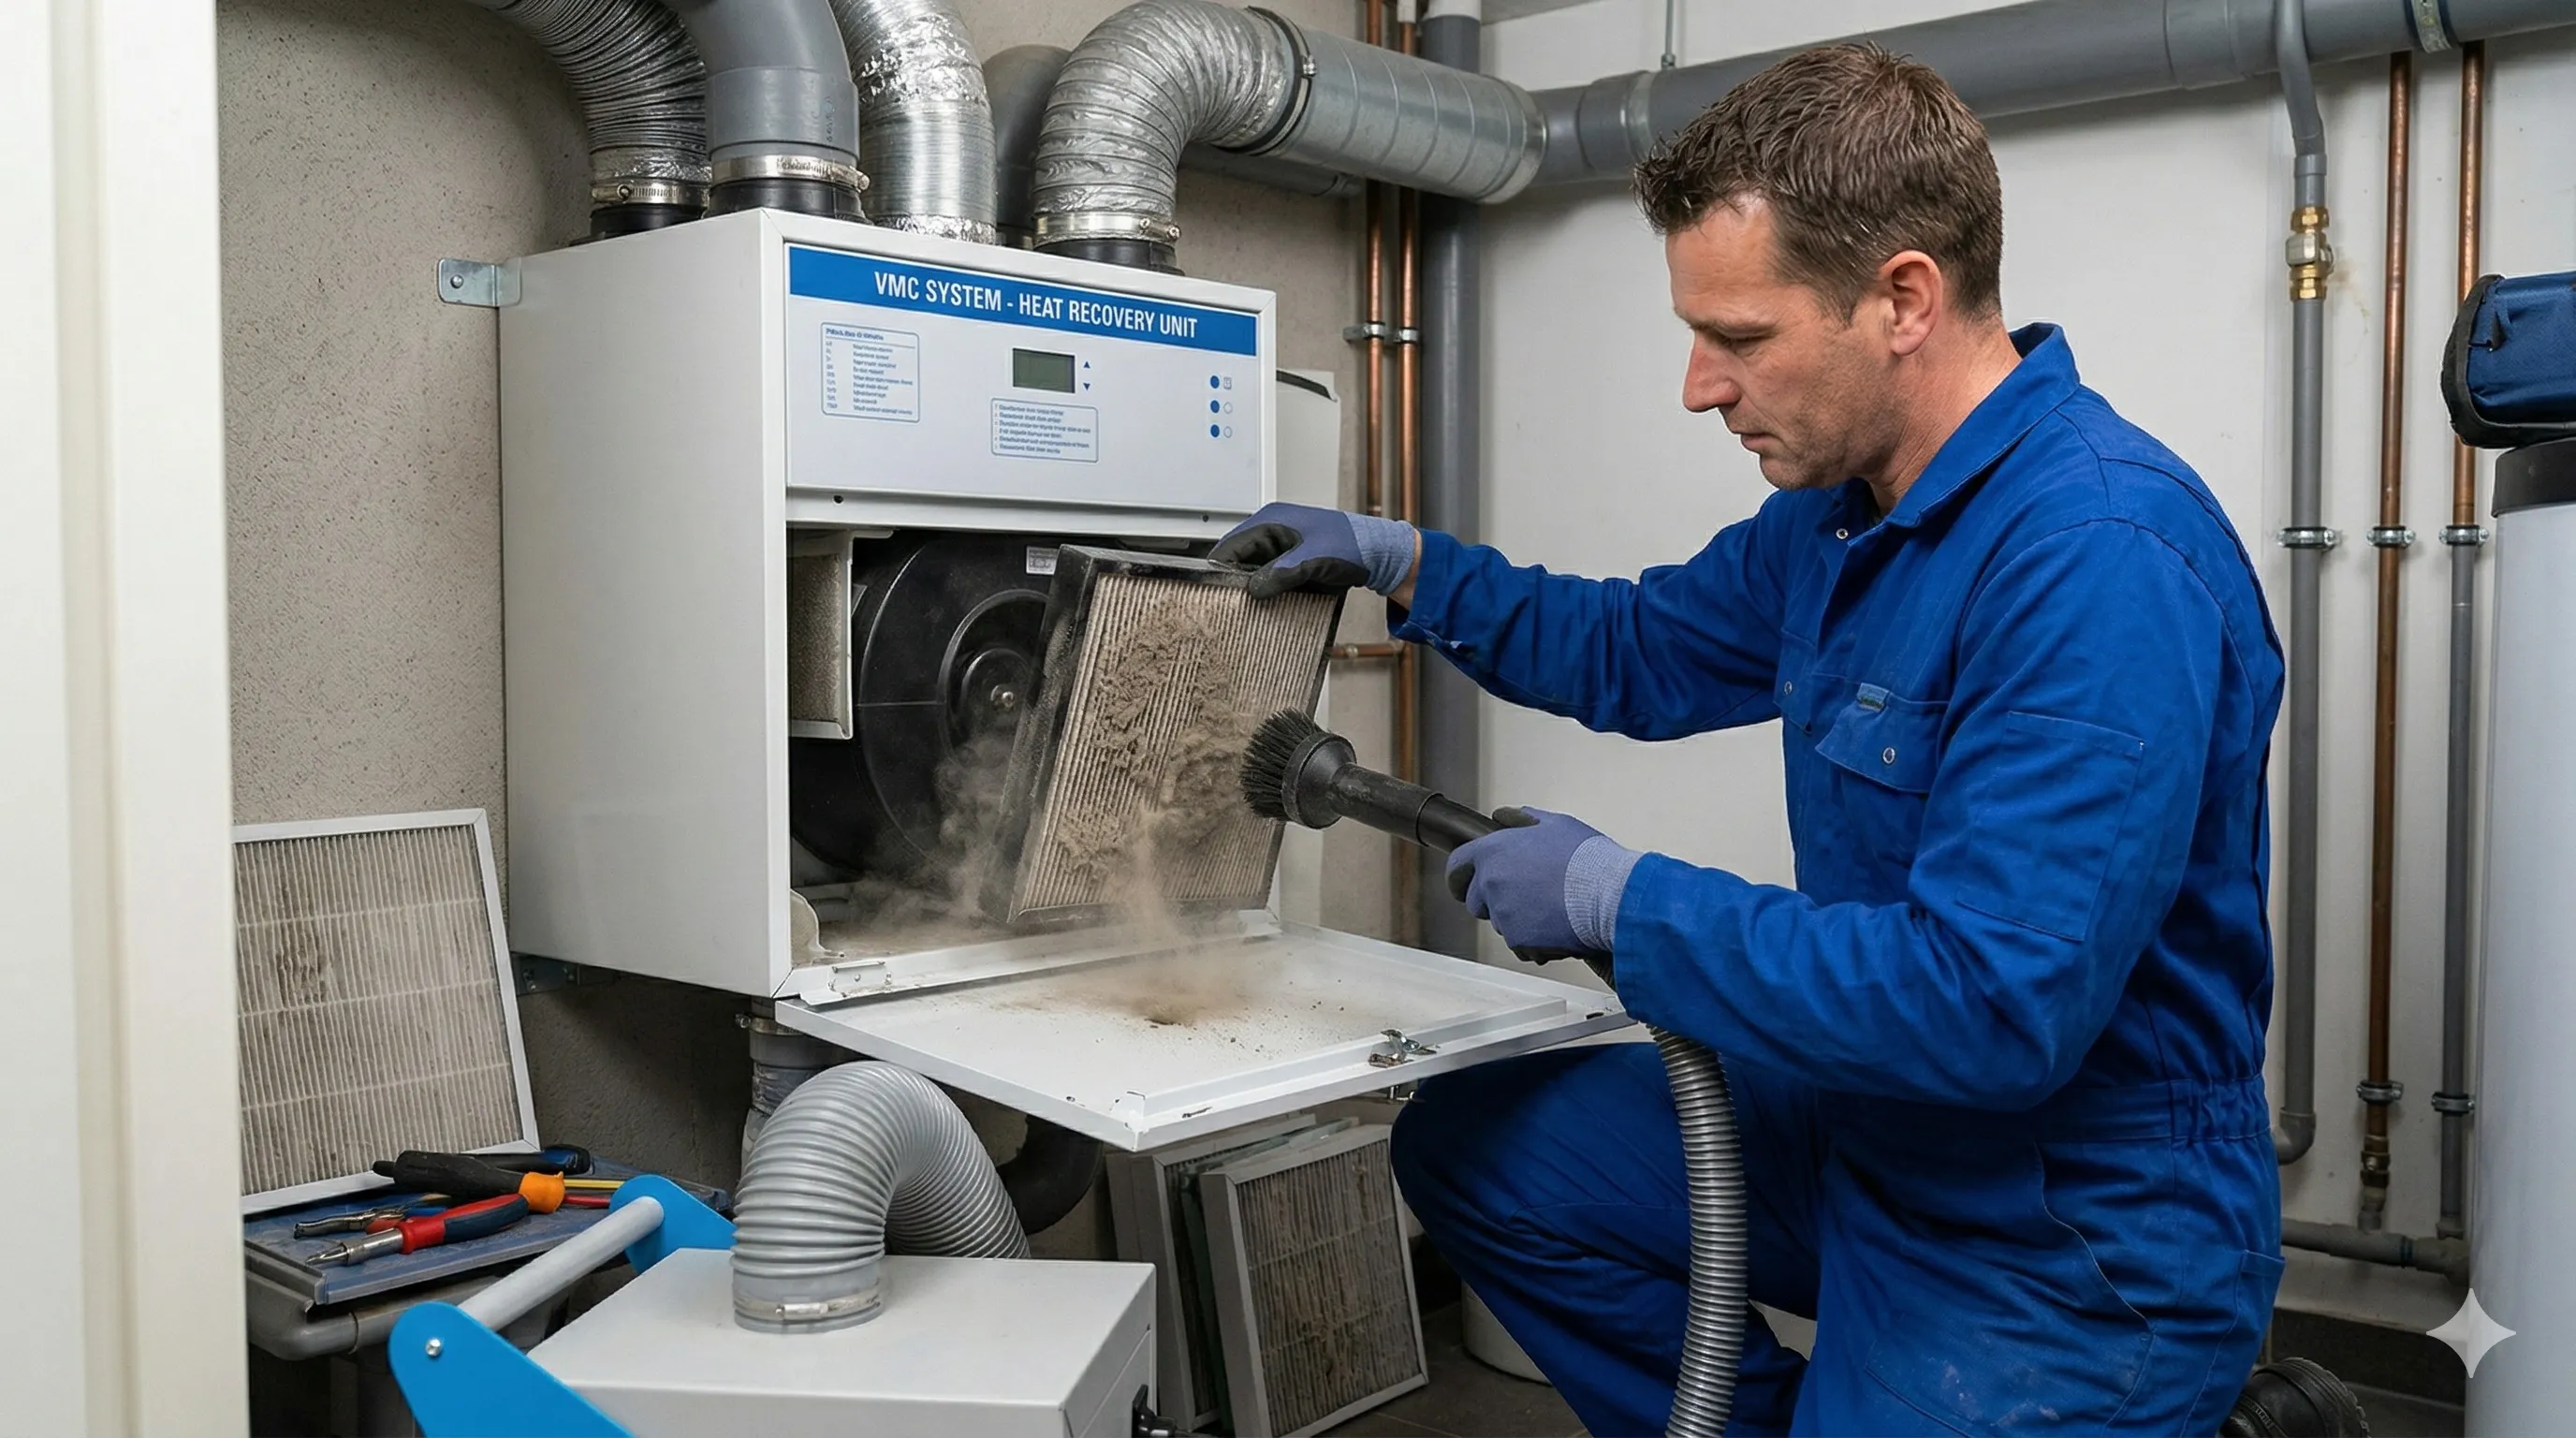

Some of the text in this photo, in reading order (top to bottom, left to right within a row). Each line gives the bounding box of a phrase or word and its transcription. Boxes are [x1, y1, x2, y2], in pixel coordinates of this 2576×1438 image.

[874, 271, 919, 301] VMC
[925, 279, 1002, 312] SYSTEM
[1019, 292, 1063, 319] HEAT
[1069, 300, 1155, 333] RECOVERY
[1160, 313, 1198, 338] UNIT
